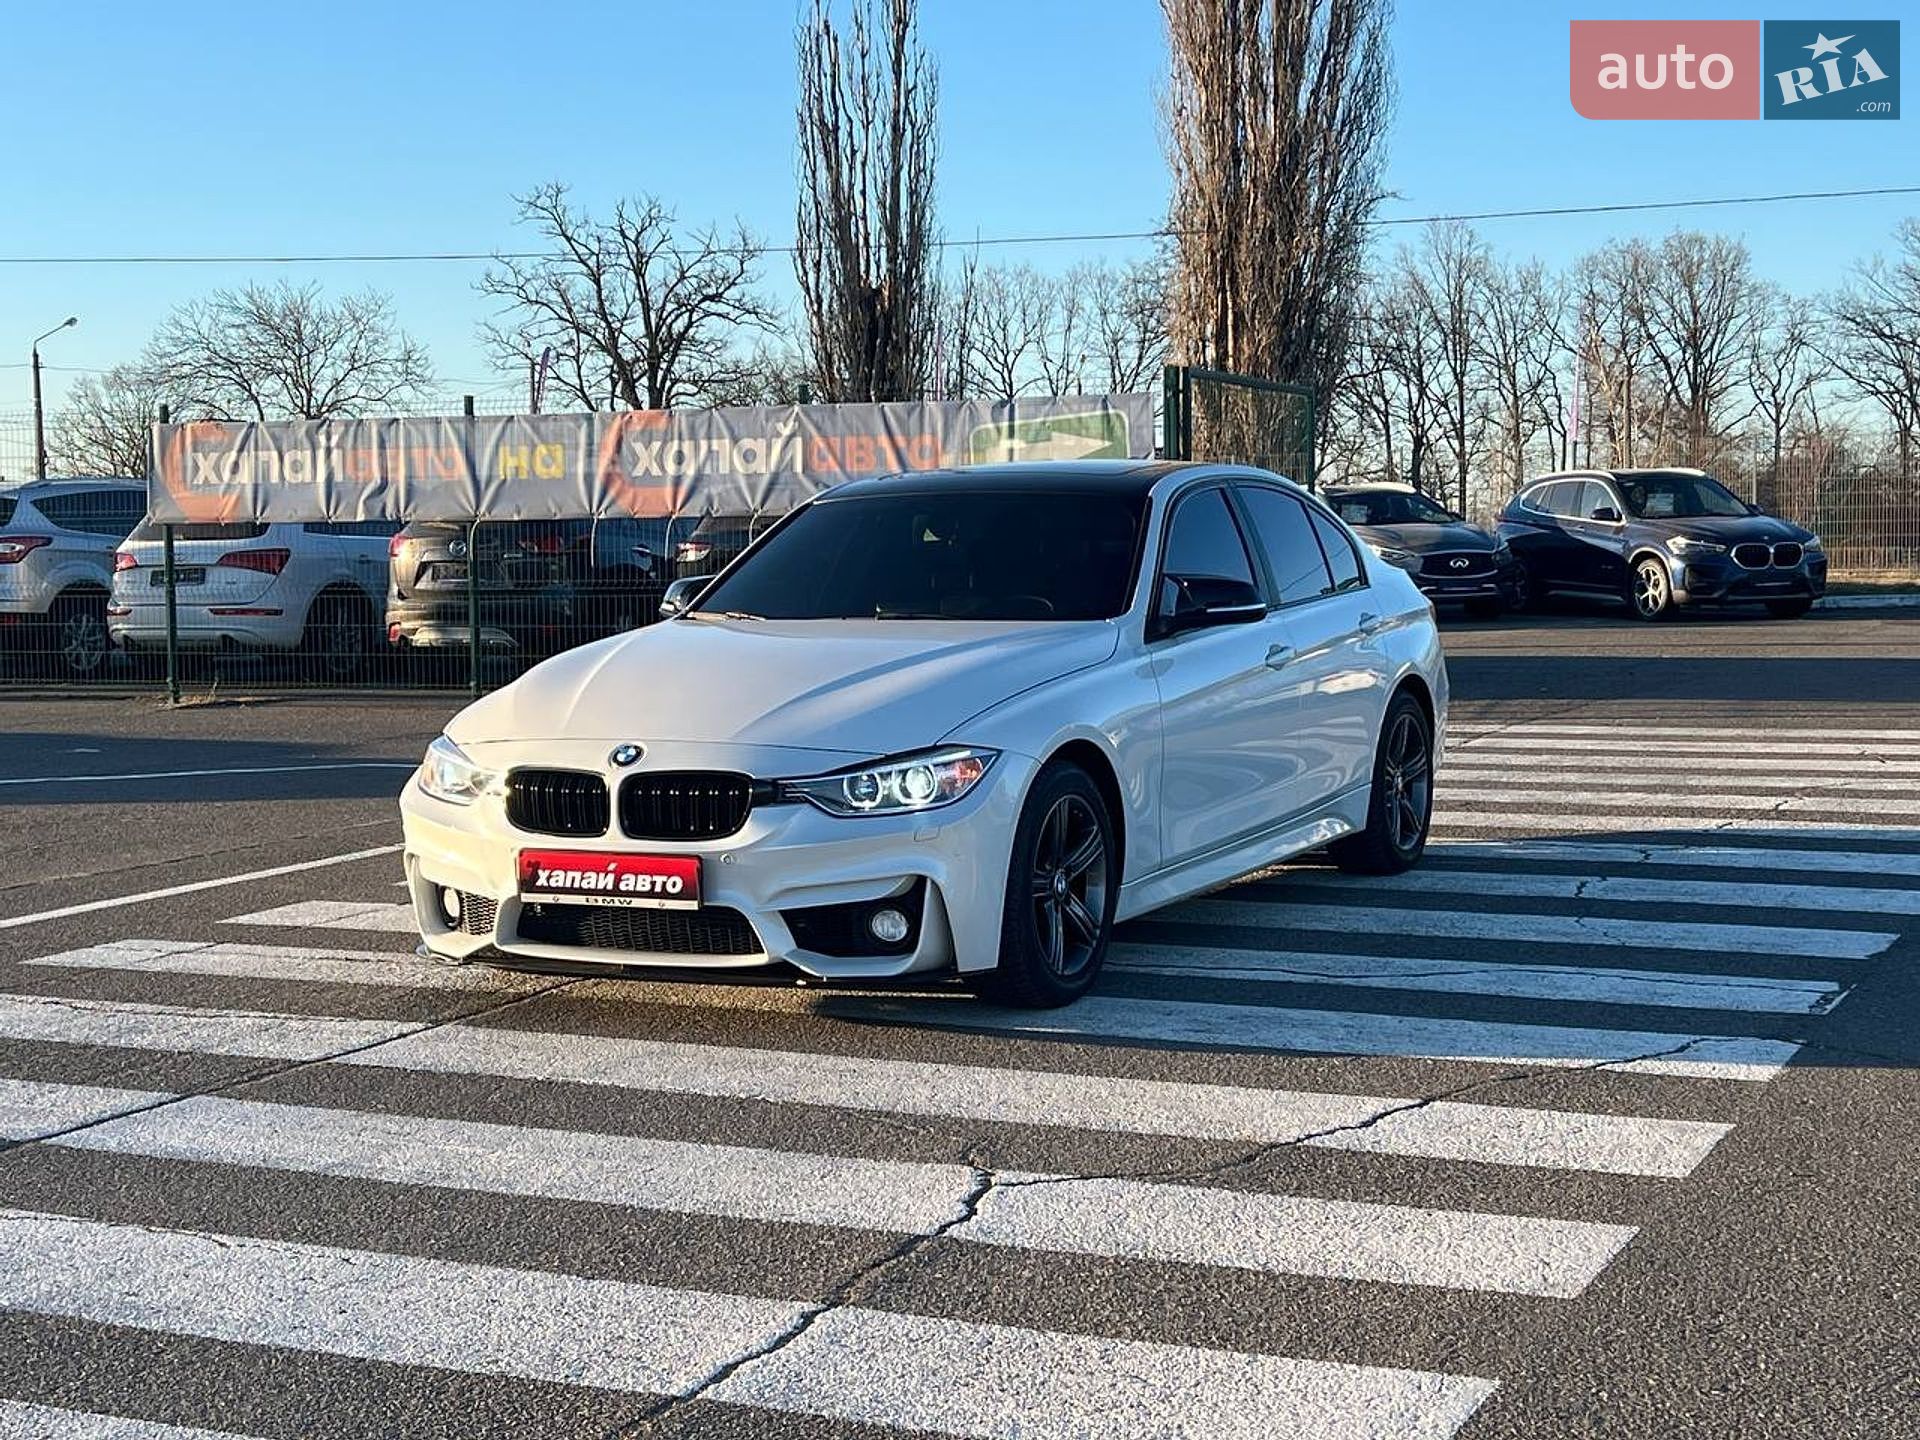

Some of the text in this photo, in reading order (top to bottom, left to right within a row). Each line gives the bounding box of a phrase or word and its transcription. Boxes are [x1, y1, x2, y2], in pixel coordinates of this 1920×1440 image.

[499, 443, 565, 480] на
[535, 862, 684, 895] хапай авто
